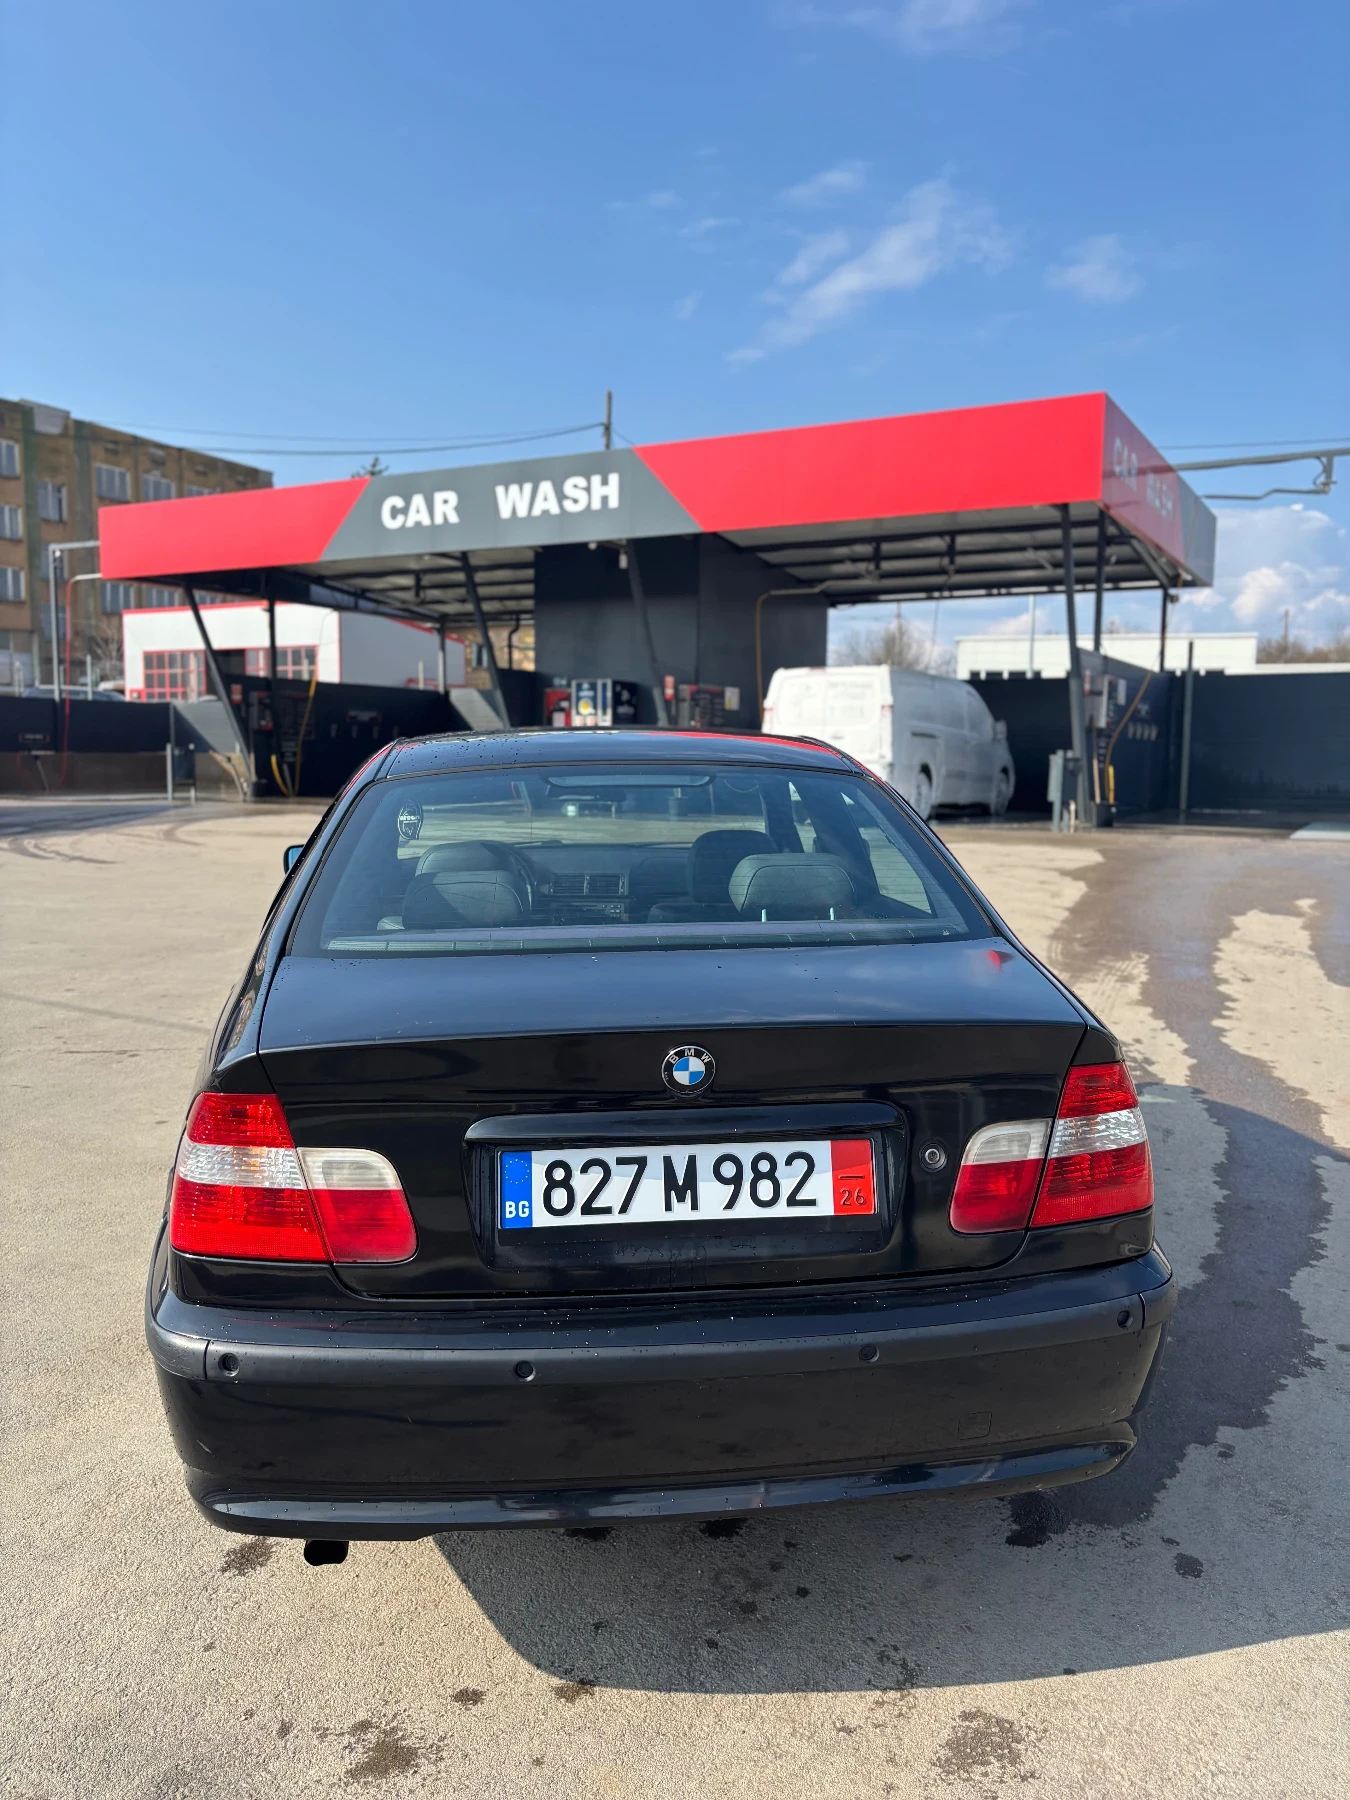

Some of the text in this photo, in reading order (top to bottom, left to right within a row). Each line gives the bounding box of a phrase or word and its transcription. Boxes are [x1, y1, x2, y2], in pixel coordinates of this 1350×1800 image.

[381, 472, 620, 530] CAR WASH
[668, 1048, 711, 1064] BMW
[542, 1151, 817, 1217] 827 M 982
[840, 1188, 866, 1207] 26
[505, 1201, 530, 1219] BG
